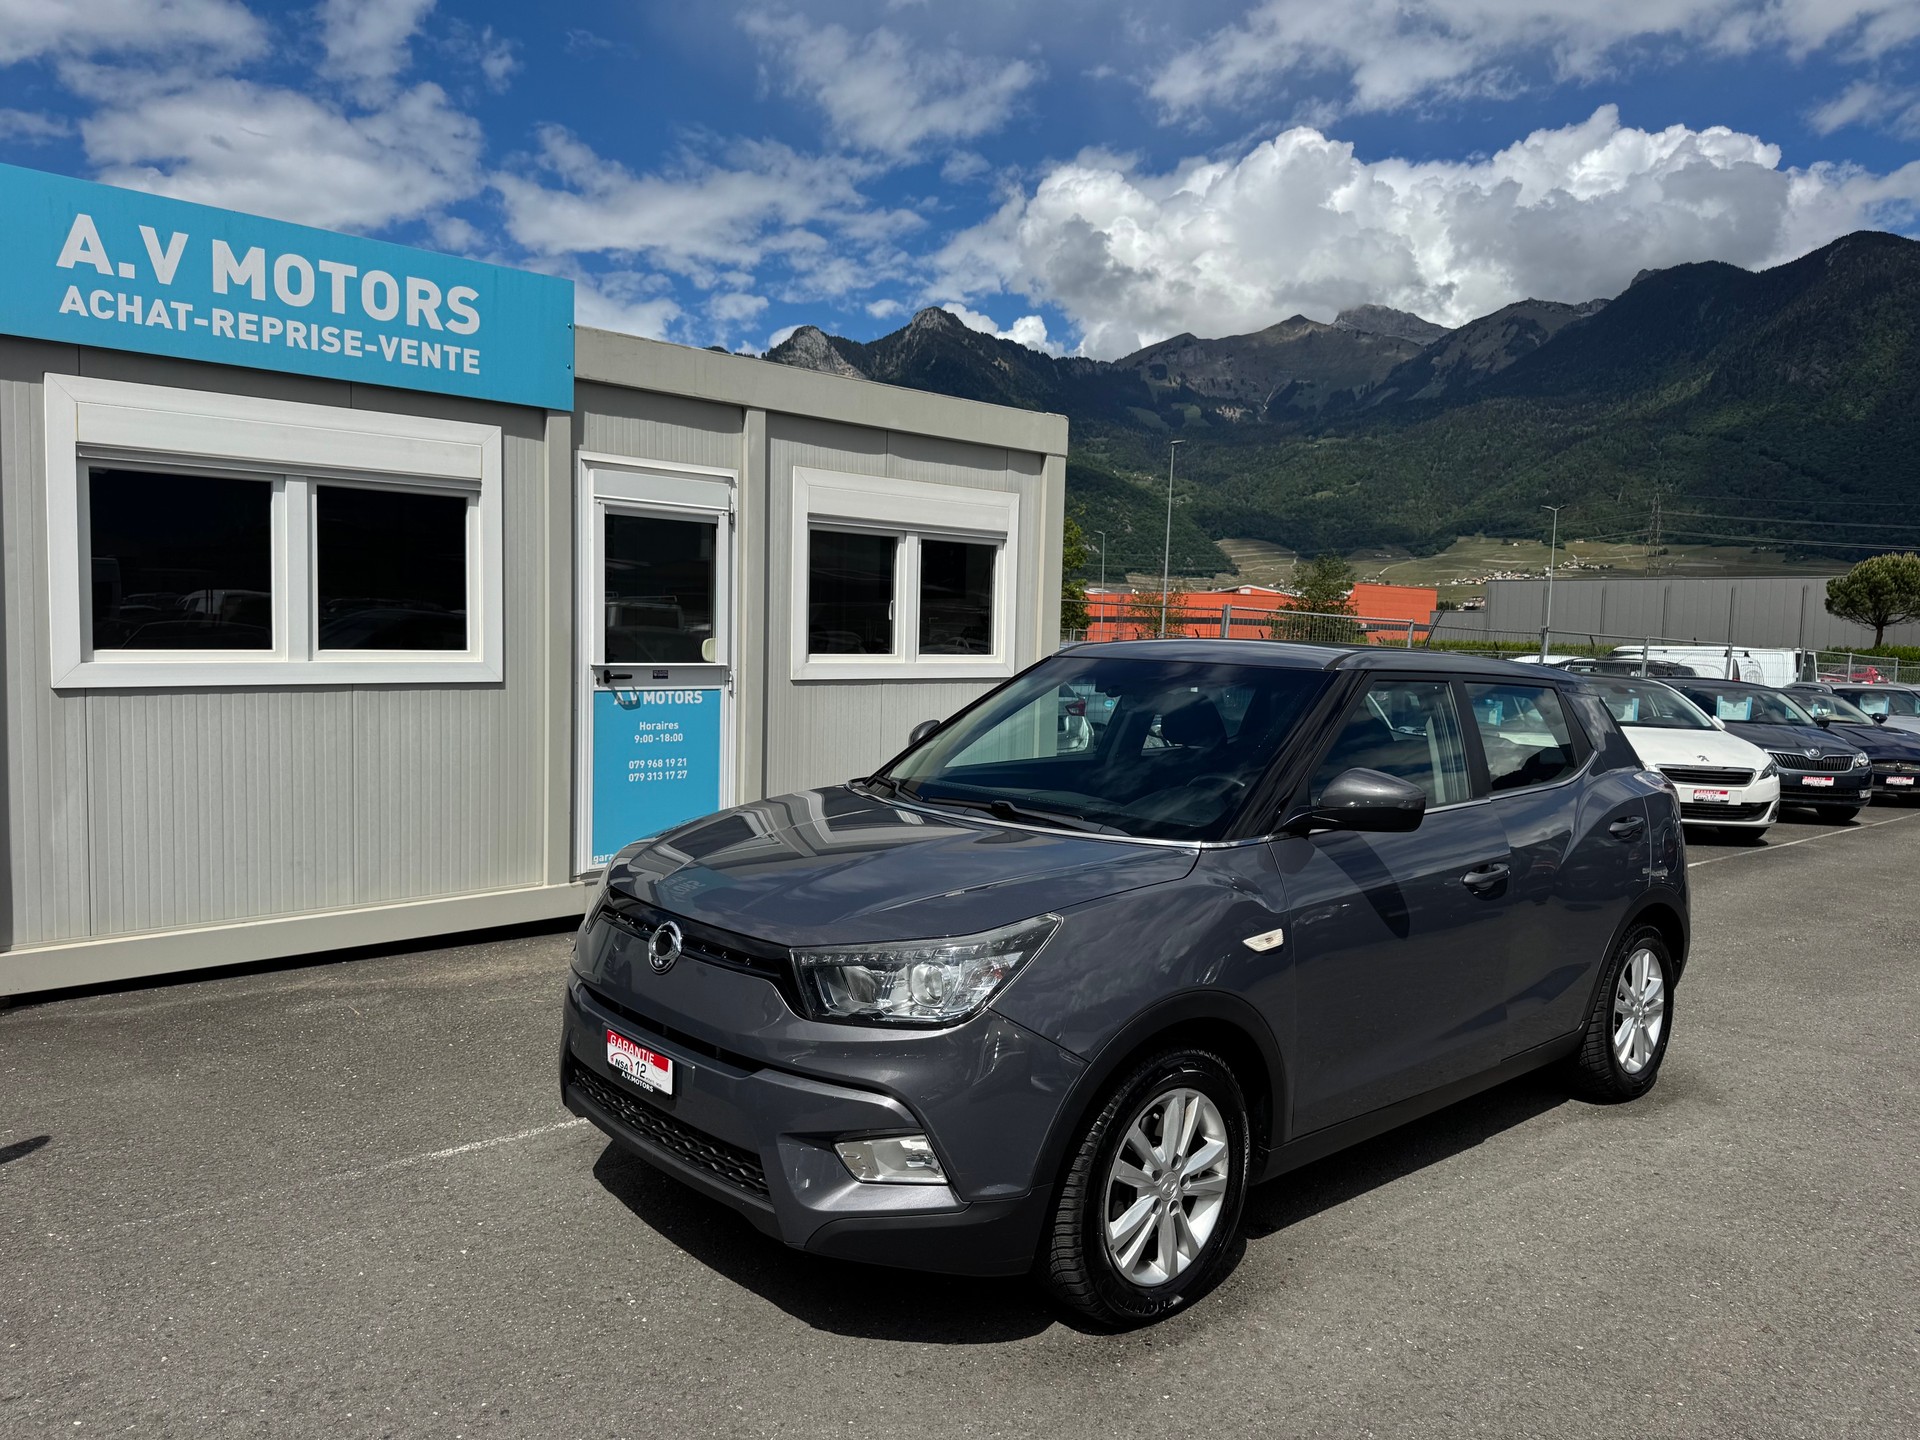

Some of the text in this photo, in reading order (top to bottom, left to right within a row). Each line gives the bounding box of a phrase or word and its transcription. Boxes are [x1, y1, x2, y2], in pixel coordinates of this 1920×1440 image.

[56, 213, 481, 335] A.V MOTORS
[59, 285, 481, 375] ACHAT-REPRISE-VENTE
[643, 690, 703, 705] MOTORS
[639, 721, 679, 731] Horaires
[634, 735, 654, 744] 9:00
[628, 758, 687, 769] 079 968 19 21
[628, 770, 688, 782] 079 313 17 27
[610, 1034, 655, 1066] GARANTIE
[615, 1058, 647, 1079] NSA 12
